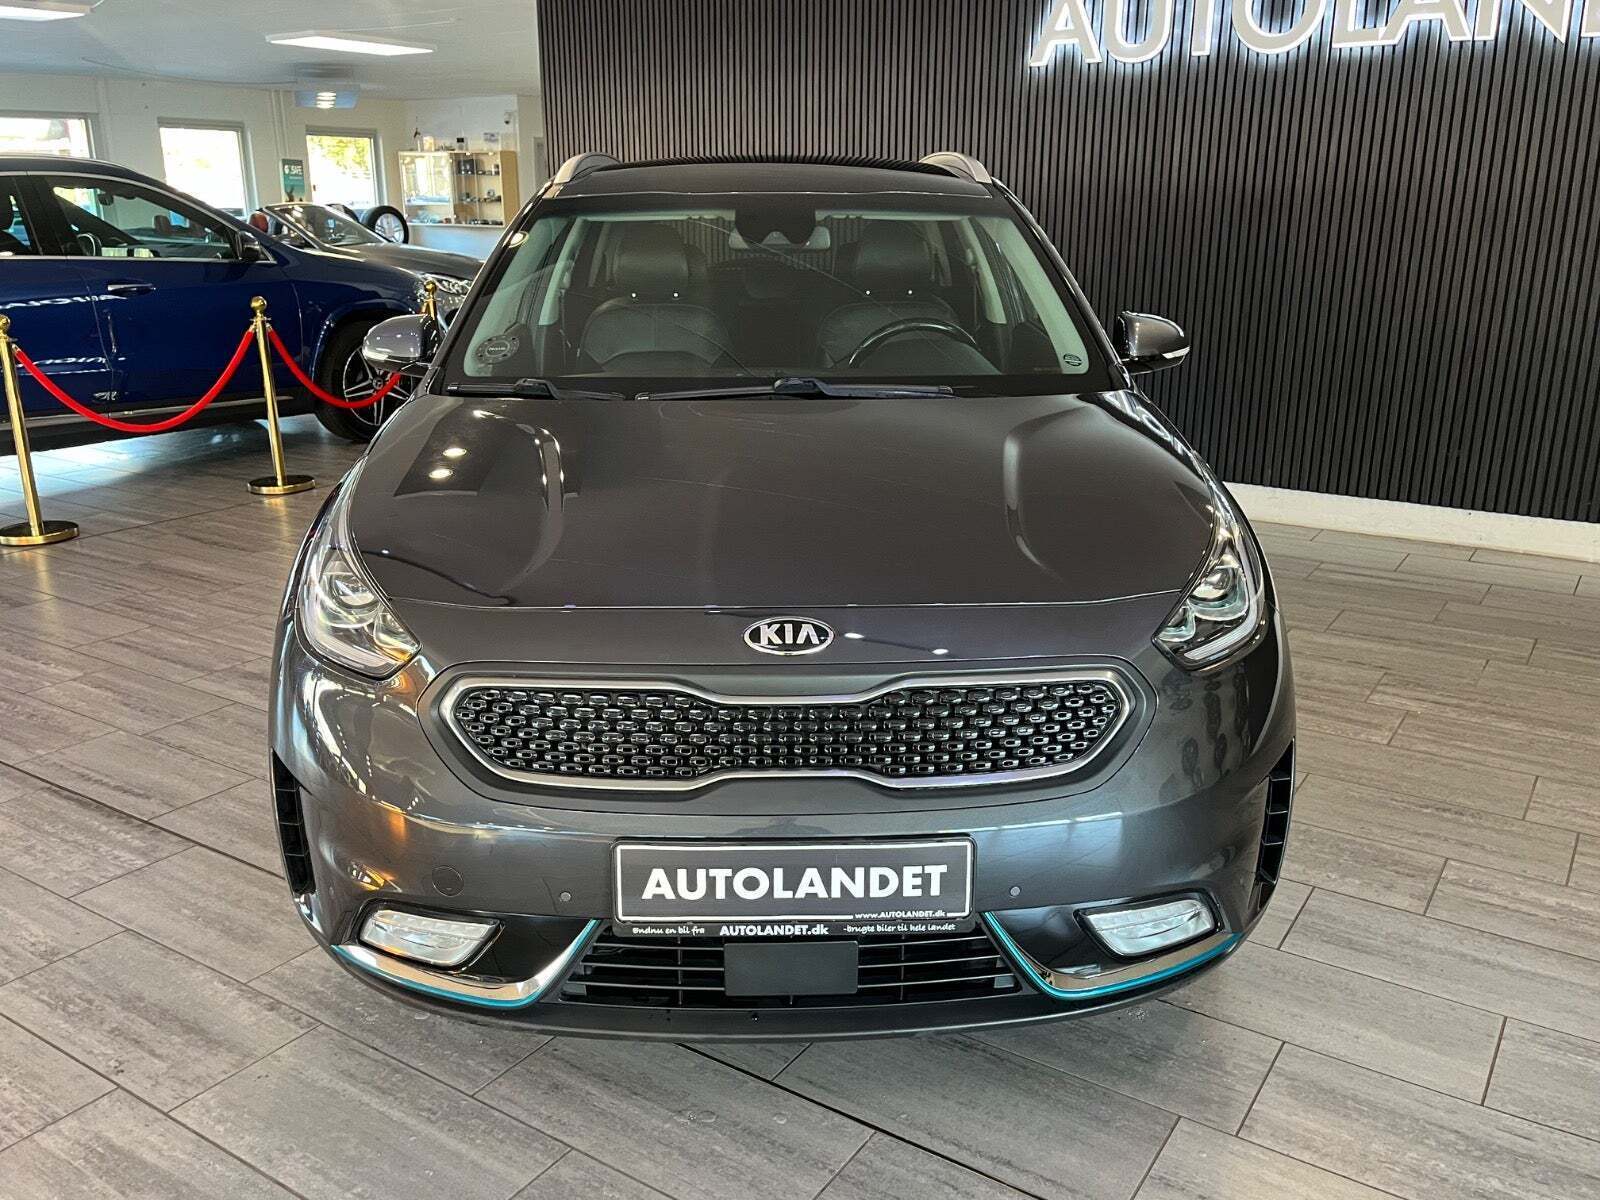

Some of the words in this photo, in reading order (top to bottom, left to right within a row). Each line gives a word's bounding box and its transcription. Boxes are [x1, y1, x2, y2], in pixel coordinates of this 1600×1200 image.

[1029, 0, 1600, 67] AUTOLAN
[760, 623, 820, 645] KIA
[641, 864, 948, 901] AUTOLANDET
[855, 910, 946, 919] www.AUTOLANDET.dk
[678, 926, 690, 934] bil
[691, 926, 705, 936] fra
[720, 924, 829, 936] AUTOLANDET.dk
[876, 923, 896, 932] biler
[897, 923, 908, 932] til
[909, 923, 926, 932] hele
[927, 922, 957, 931] landet
